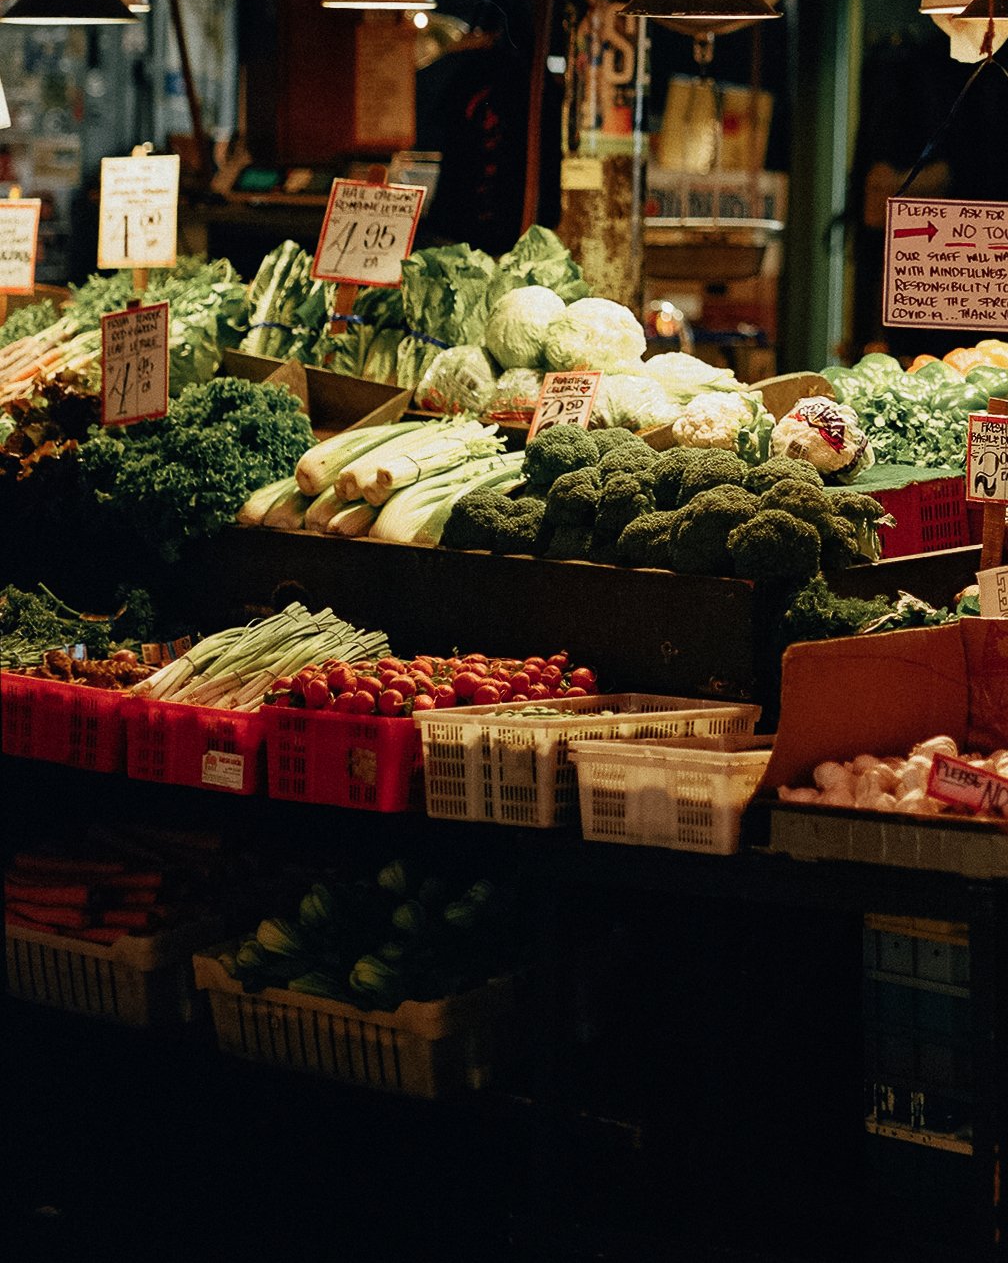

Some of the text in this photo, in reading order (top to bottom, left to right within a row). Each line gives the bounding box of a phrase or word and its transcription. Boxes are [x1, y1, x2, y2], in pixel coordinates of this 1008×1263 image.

[898, 204, 947, 218] PLEASE
[959, 207, 982, 219] ASK
[986, 210, 1004, 220] FOR
[953, 224, 976, 239] NO
[895, 251, 920, 261] OUR
[927, 251, 960, 262] STAFF
[966, 253, 990, 263] WILL
[895, 266, 924, 276] WITH
[930, 266, 1007, 280] MINDFULNESS
[895, 278, 990, 293] RESPONSIBILITY
[894, 293, 938, 307] REDUCE
[944, 297, 969, 307] THE
[958, 308, 997, 321] THANK
[981, 422, 1007, 434] FRESH
[937, 759, 981, 788] PLEASE
